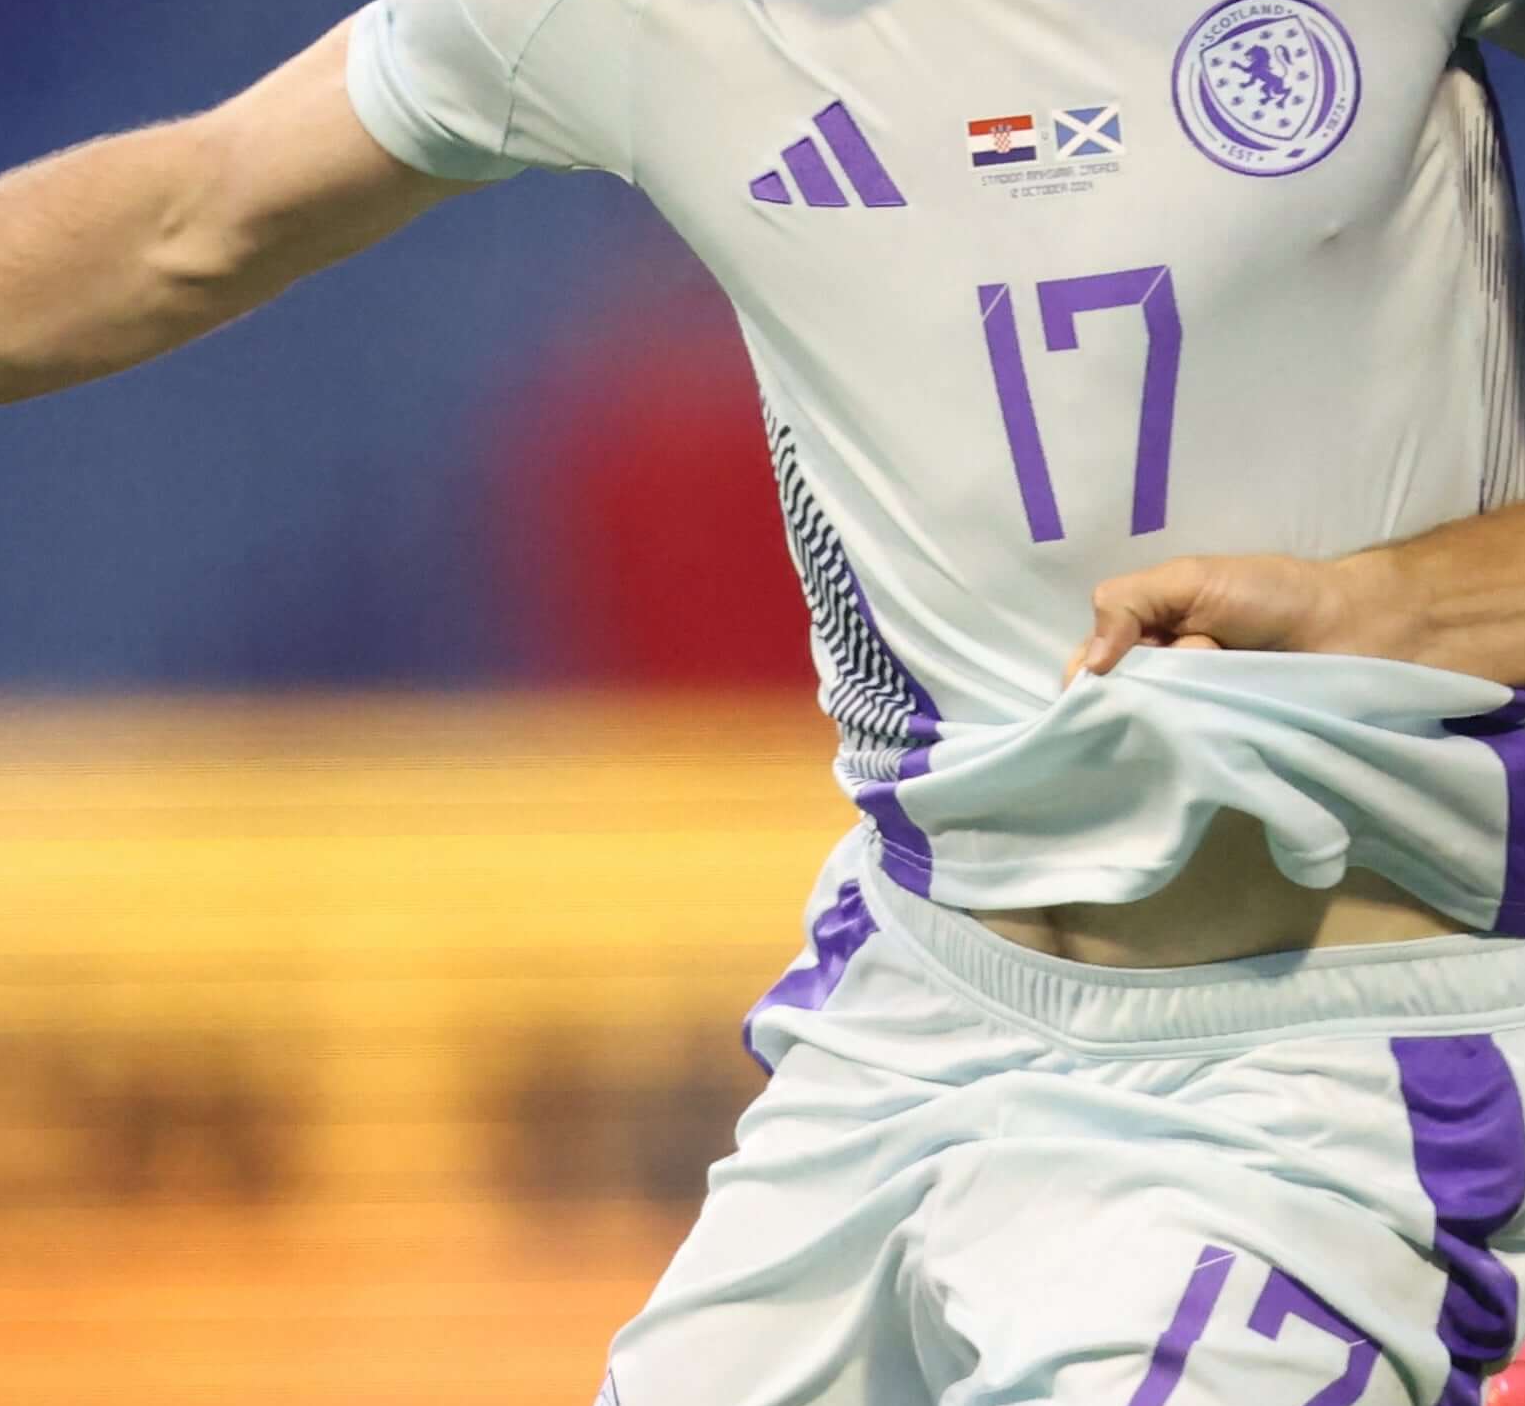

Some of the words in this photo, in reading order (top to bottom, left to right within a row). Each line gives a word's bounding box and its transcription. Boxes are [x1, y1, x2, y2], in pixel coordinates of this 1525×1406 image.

[1204, 4, 1285, 42] SCOTLAND
[1228, 146, 1254, 162] EST
[978, 265, 1183, 544] 17
